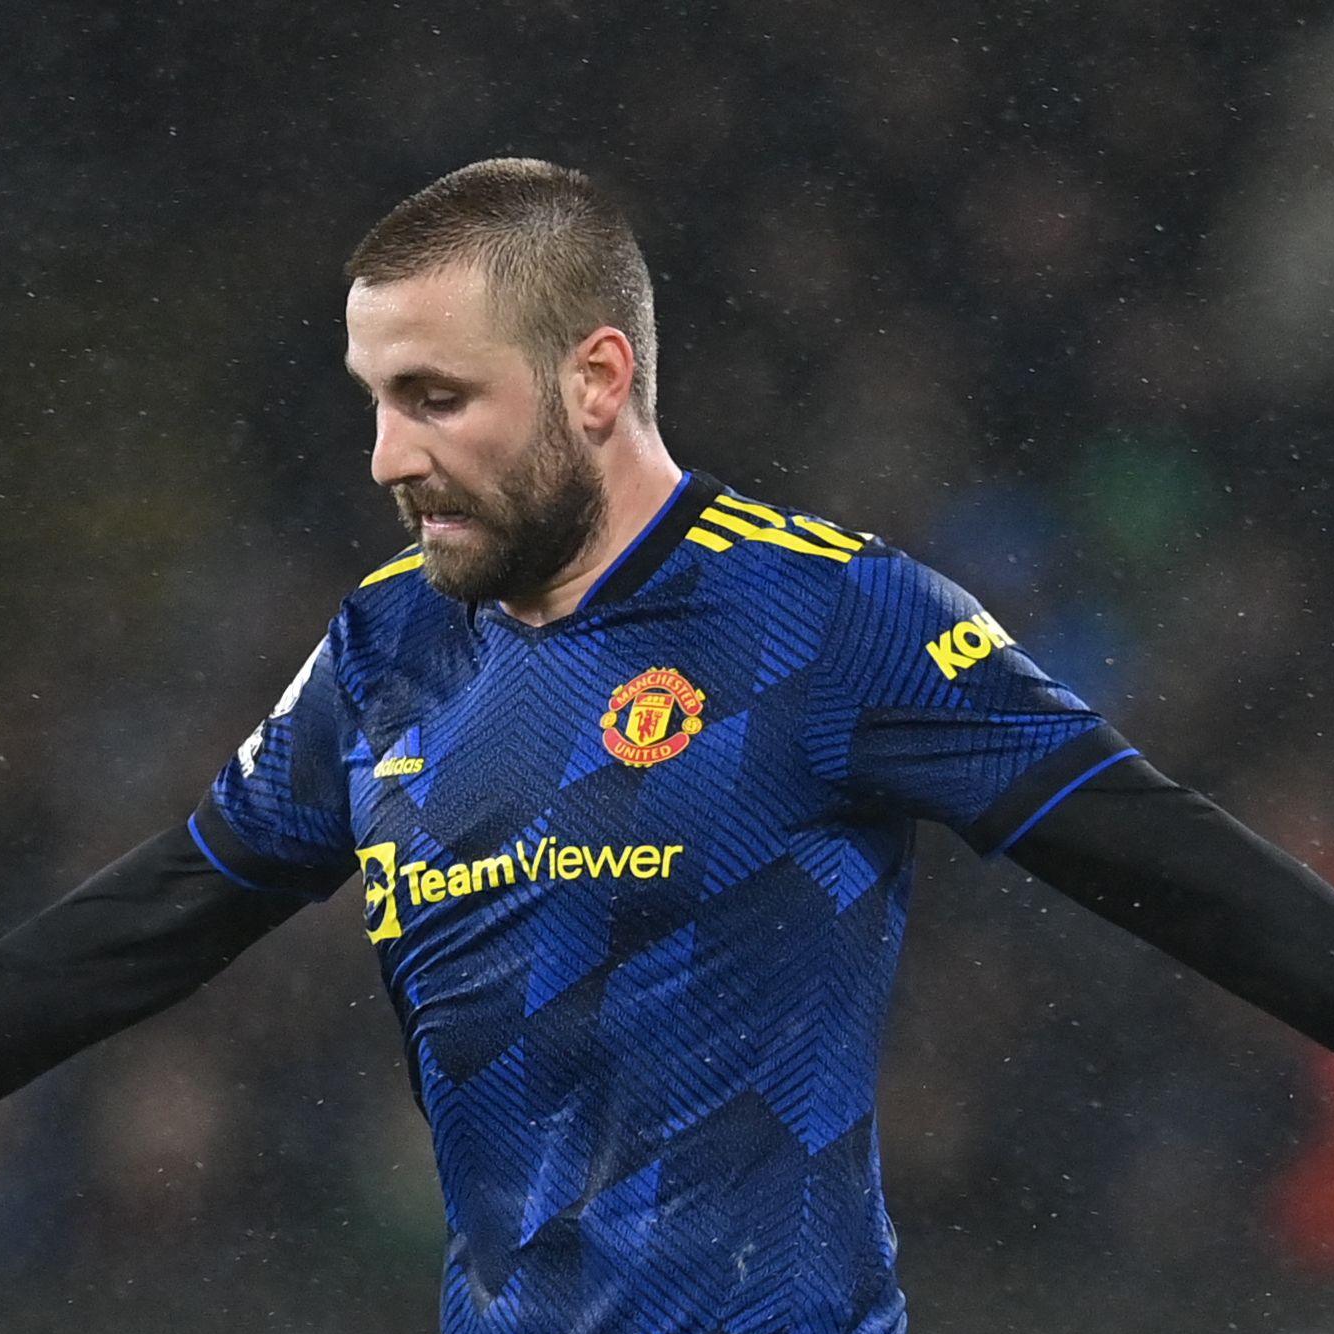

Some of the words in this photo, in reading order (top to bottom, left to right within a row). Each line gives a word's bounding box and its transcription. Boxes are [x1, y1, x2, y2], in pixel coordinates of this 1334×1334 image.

[616, 673, 697, 710] MANCHESTER
[614, 741, 672, 761] UNITED
[373, 756, 425, 779] adidas
[400, 836, 683, 906] TeamViewer
